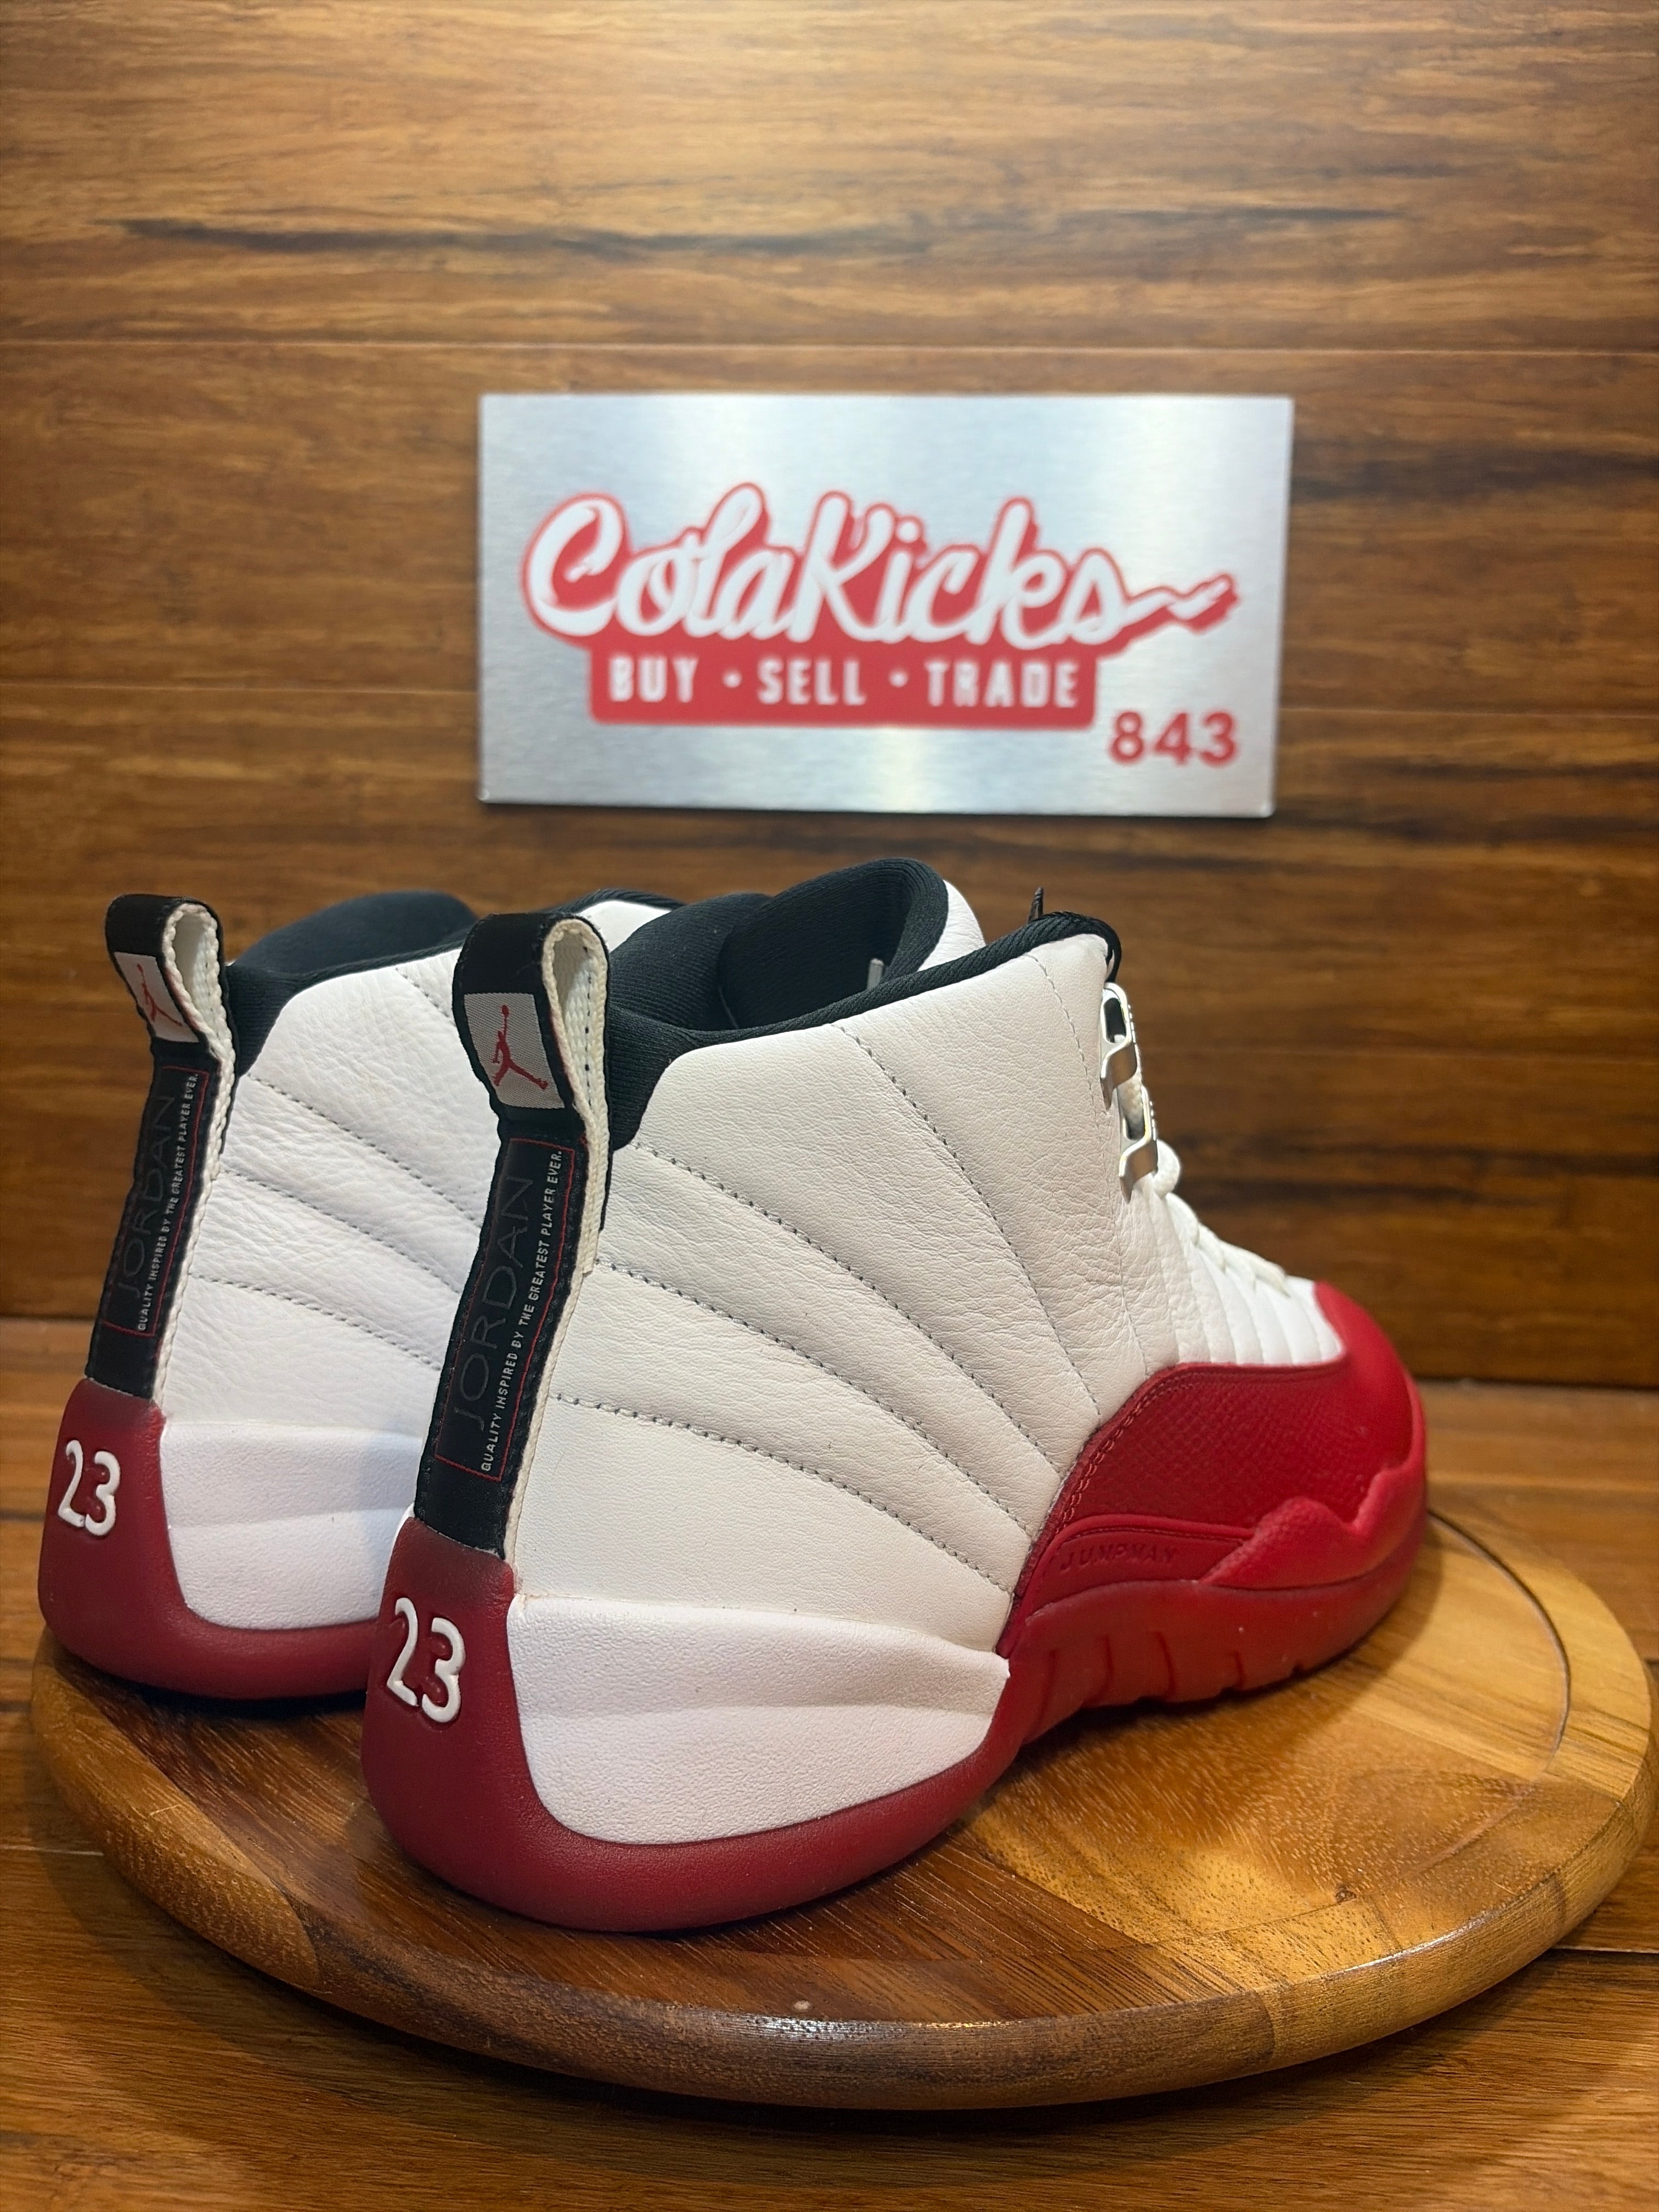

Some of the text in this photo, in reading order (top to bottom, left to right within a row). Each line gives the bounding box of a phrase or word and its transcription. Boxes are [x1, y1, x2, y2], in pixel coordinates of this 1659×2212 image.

[608, 655, 1079, 708] BUY SELL TRADE
[1108, 710, 1238, 766] 843
[178, 1103, 191, 1143] PLAYER
[171, 1145, 187, 1195] GREATEST
[118, 1097, 174, 1299] JORDAN
[166, 1197, 179, 1215] THE
[160, 1218, 171, 1233] BY
[148, 1233, 167, 1282] INSPIRED
[137, 1282, 154, 1332] QUALITY
[454, 1176, 534, 1431] JORDAN
[480, 1150, 563, 1474] QUALITY INSPIRED BY THE GREATEST PLAYER EVER.
[57, 1439, 121, 1536] 23
[1059, 1542, 1177, 1573] JUMPMAN
[386, 1596, 467, 1723] 23
